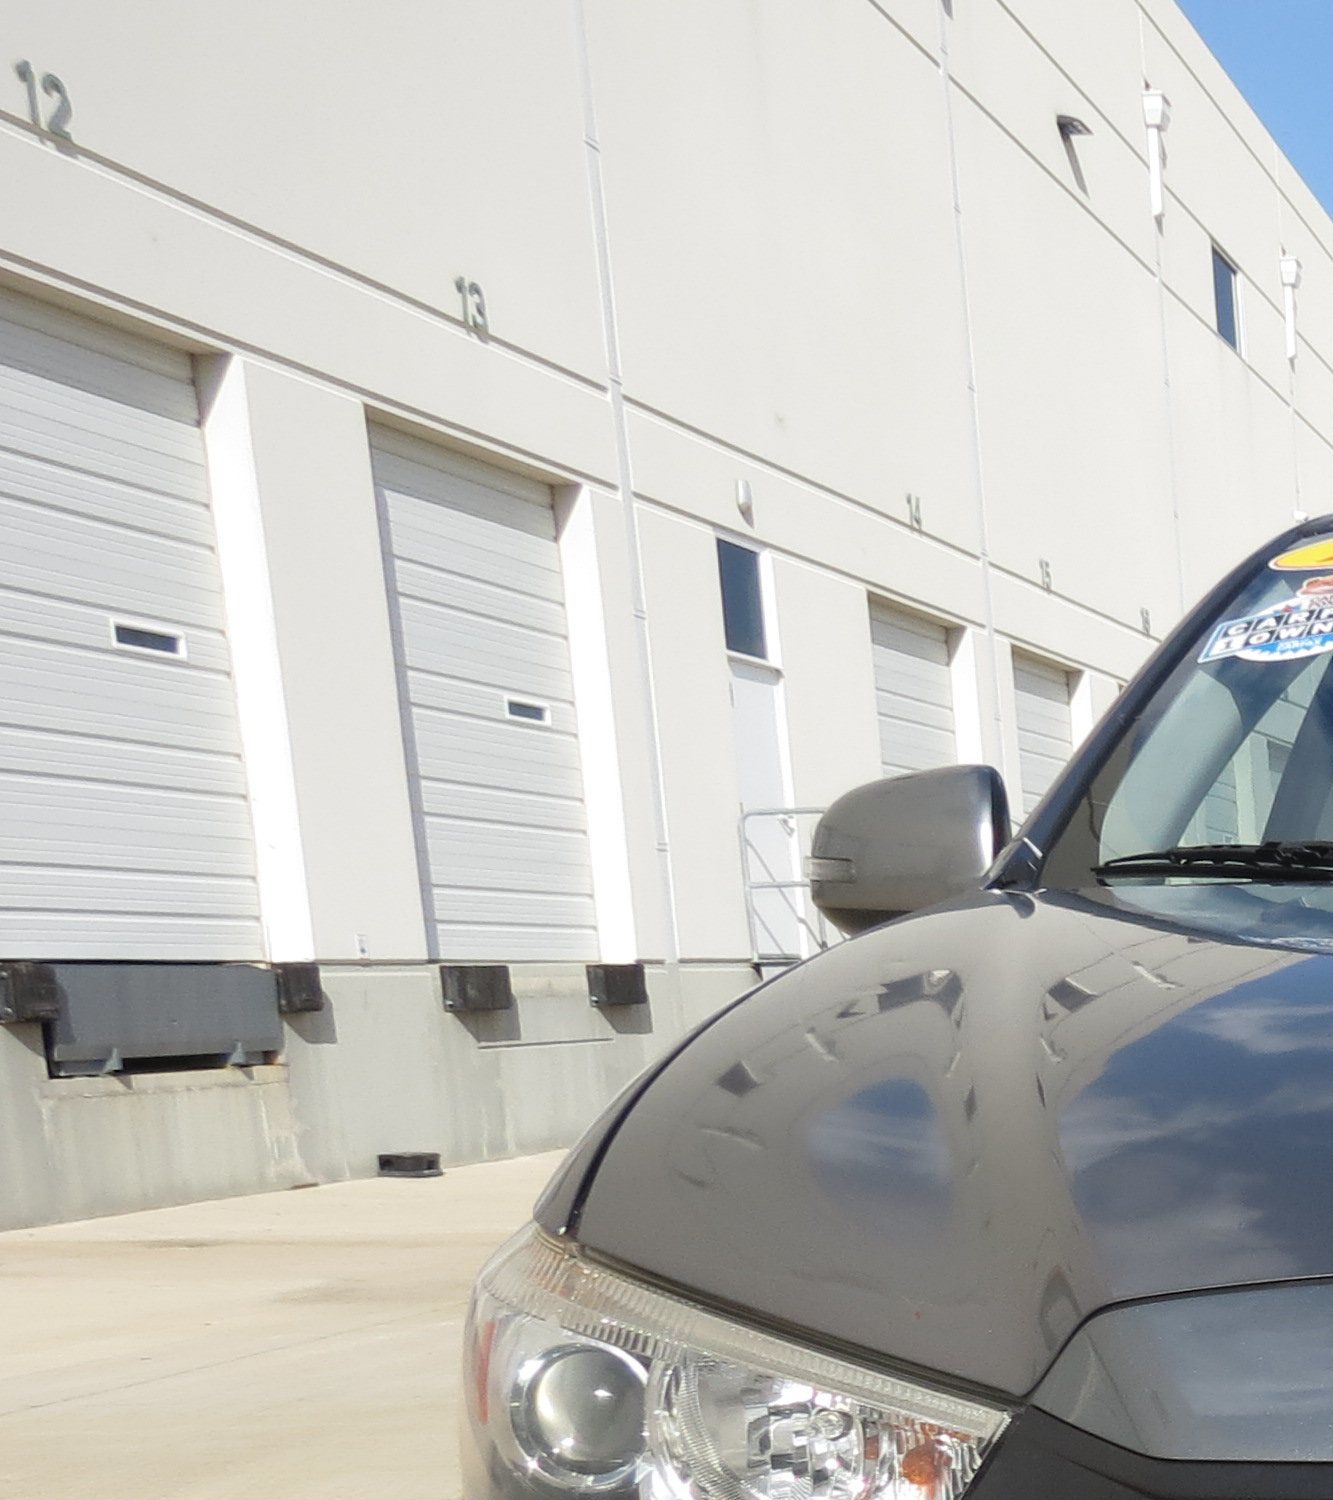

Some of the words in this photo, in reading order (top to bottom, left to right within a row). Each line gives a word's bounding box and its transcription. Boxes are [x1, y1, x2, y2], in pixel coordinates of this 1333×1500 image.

[15, 58, 73, 141] 12
[454, 275, 489, 334] 13
[906, 493, 922, 530] 14
